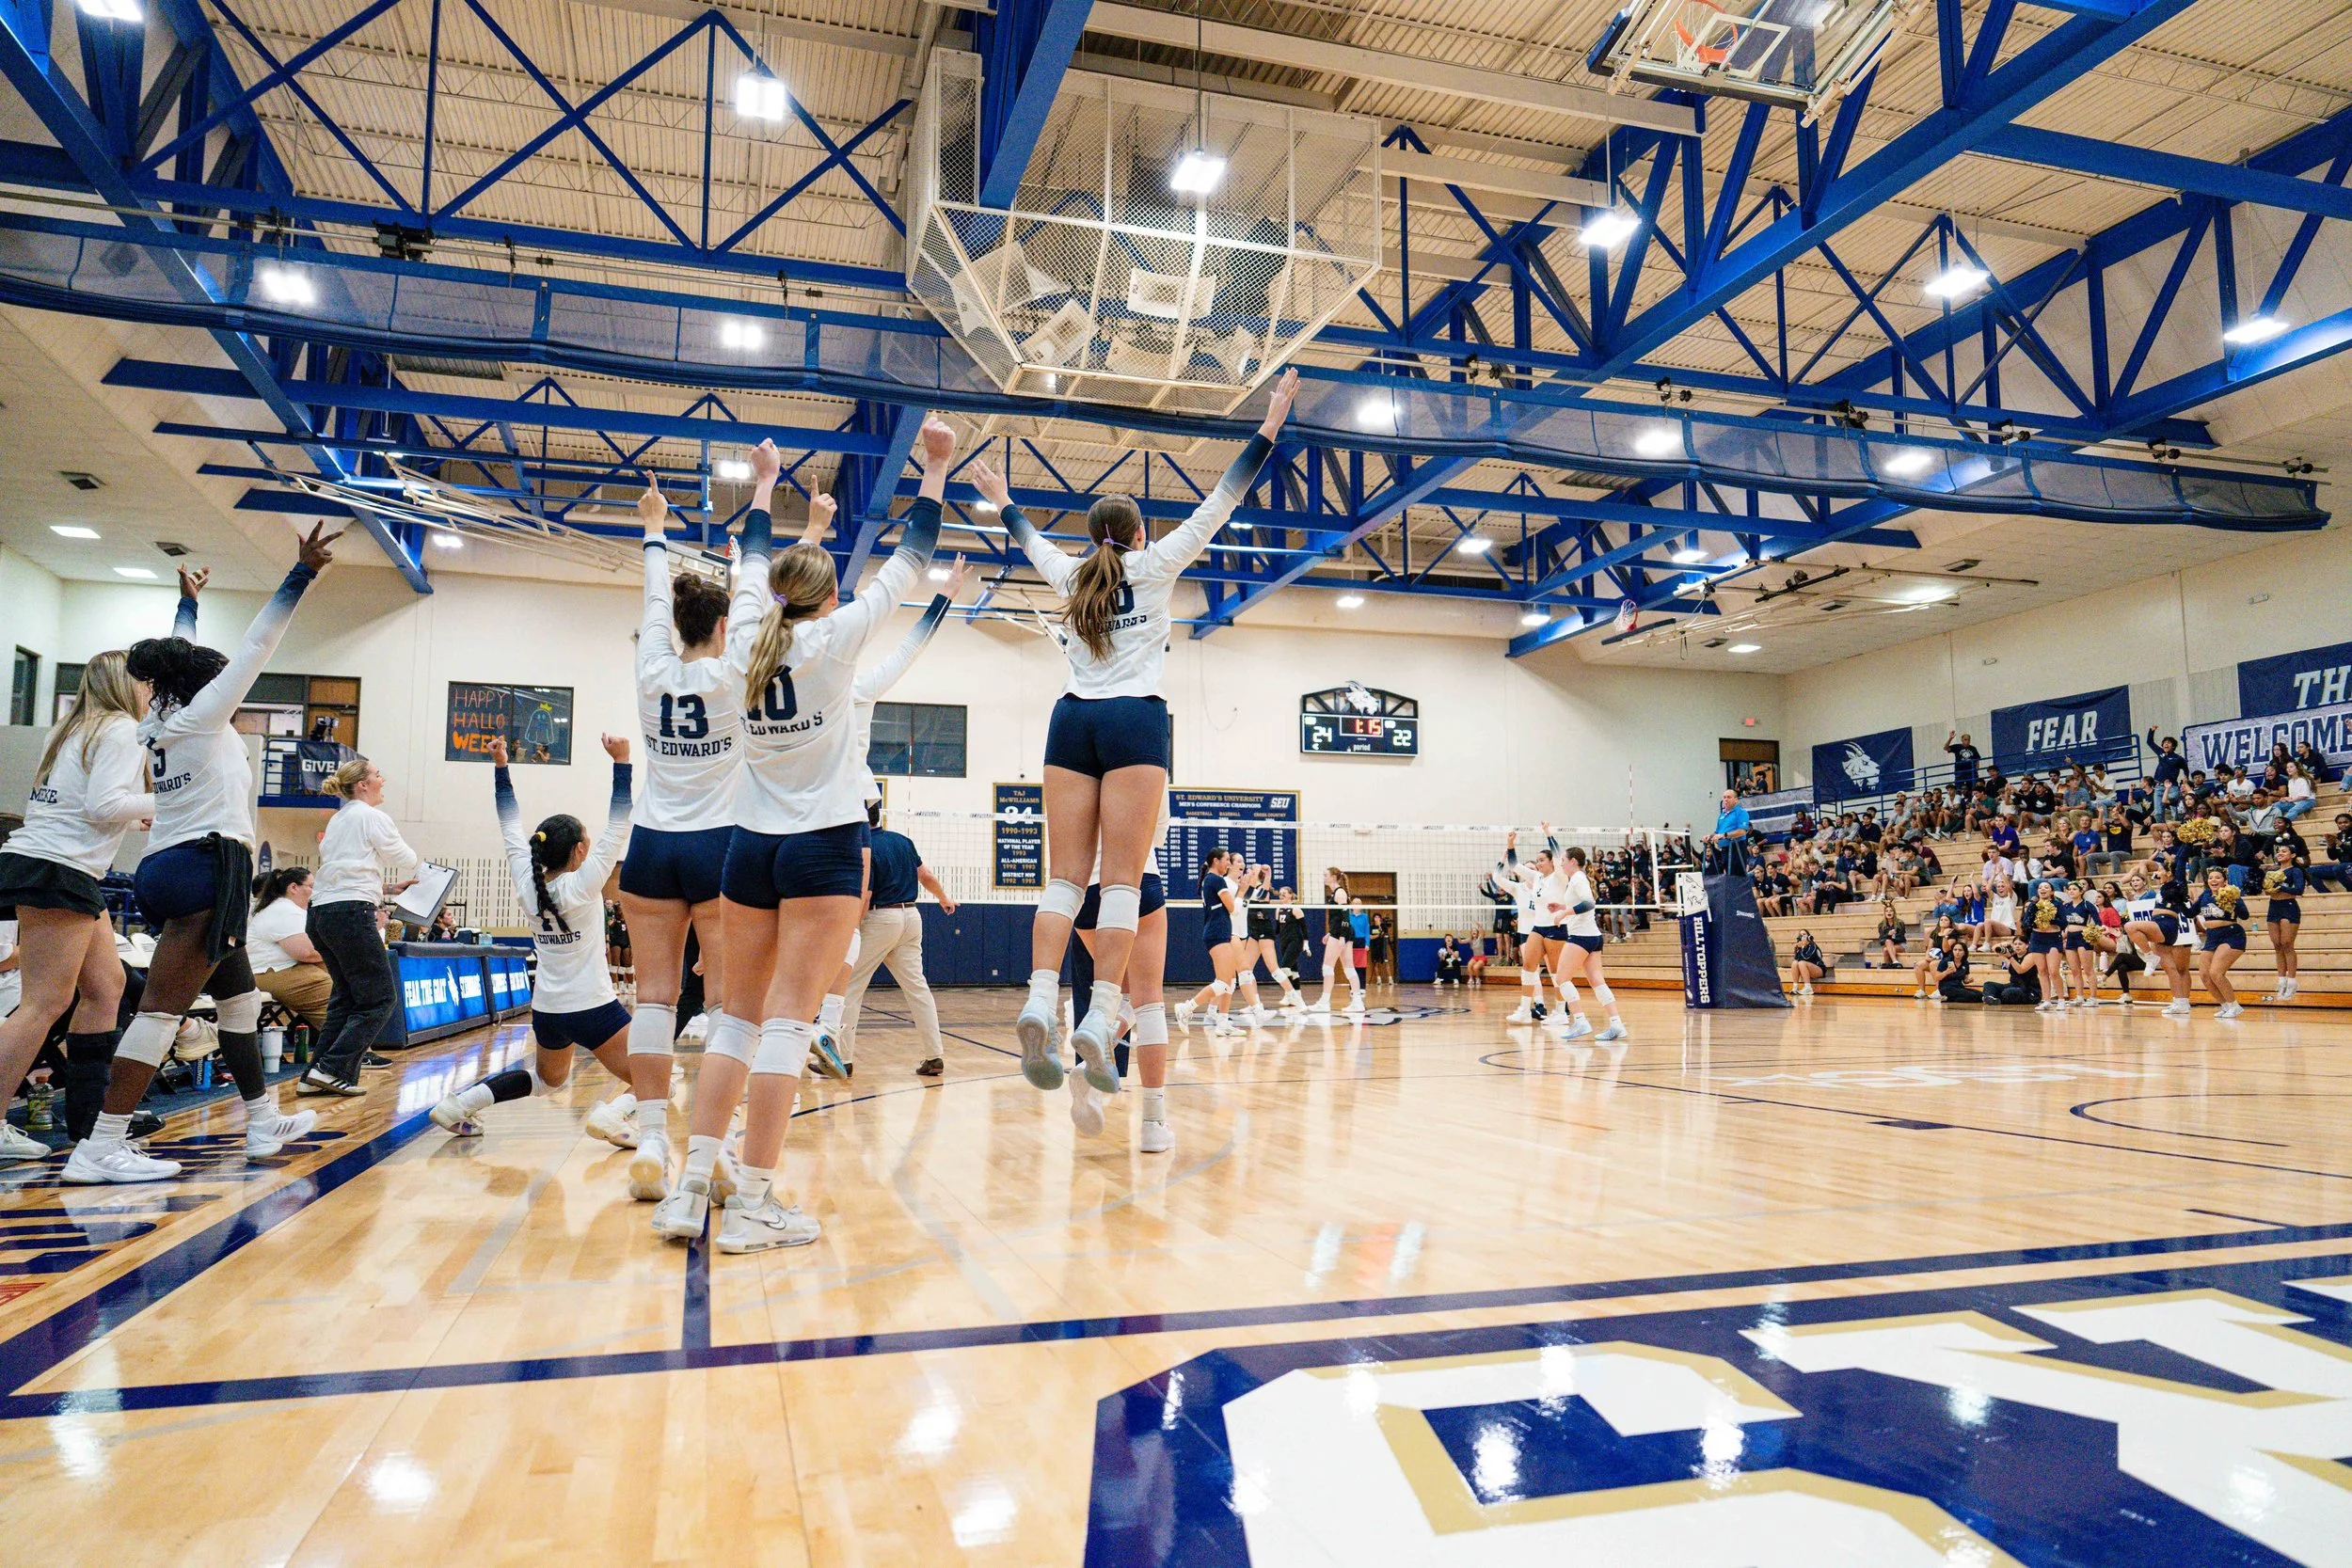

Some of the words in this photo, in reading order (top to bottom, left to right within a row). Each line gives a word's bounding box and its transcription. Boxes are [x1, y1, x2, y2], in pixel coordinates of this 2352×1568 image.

[2293, 665, 2352, 709] TH
[453, 688, 506, 709] HAPPY
[453, 711, 506, 730] HALLO
[659, 692, 709, 738] 13
[453, 730, 506, 753] WEE
[1312, 725, 1333, 743] 24
[1355, 719, 1381, 736] 1:15
[1392, 729, 1412, 747] 22
[2025, 710, 2098, 753] FEAR
[661, 736, 732, 757] EDWARD'S
[302, 758, 336, 773] GIVE
[152, 772, 191, 794] DWARD'S
[1270, 797, 1291, 809] SEU
[537, 930, 581, 945] EDWARD'S
[1693, 916, 1710, 1004] HILLTOPPERS
